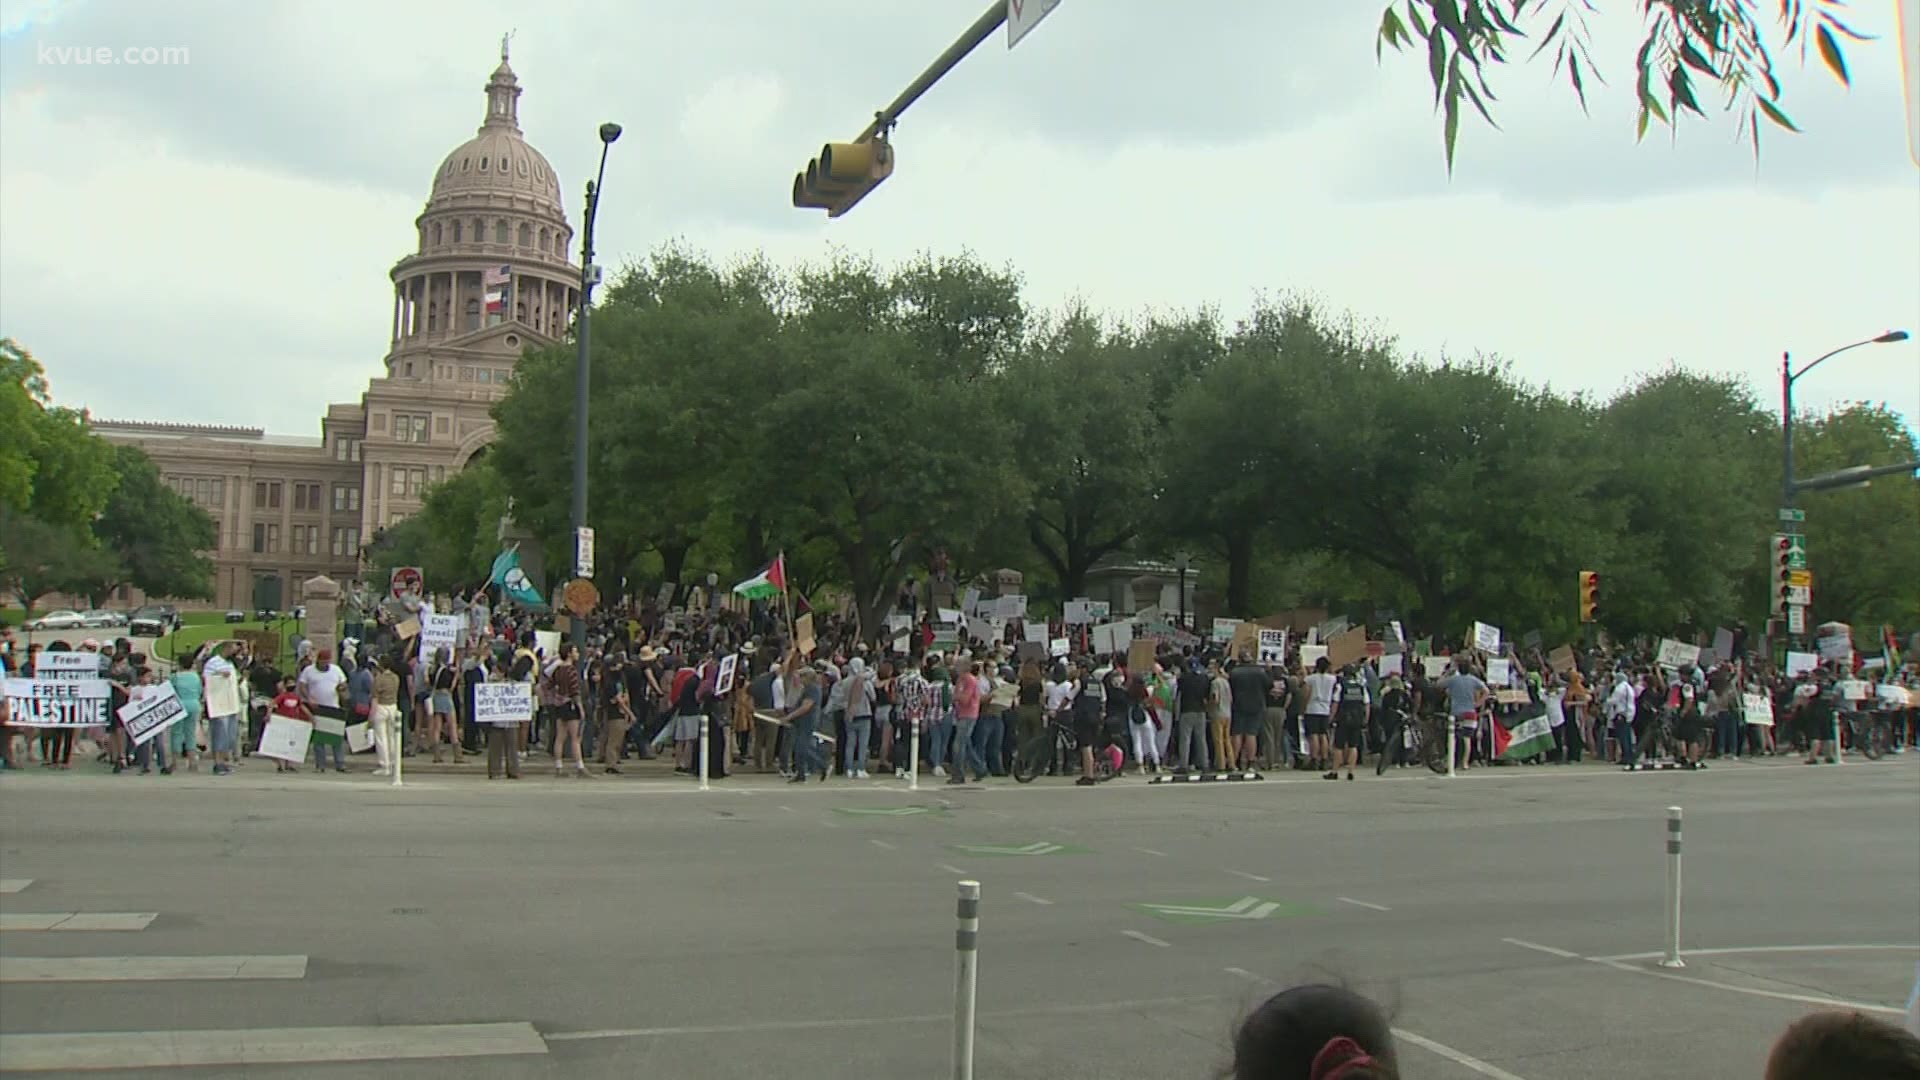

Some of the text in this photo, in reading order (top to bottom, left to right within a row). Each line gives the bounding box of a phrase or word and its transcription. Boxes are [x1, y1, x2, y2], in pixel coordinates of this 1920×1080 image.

[53, 655, 81, 664] Free
[32, 685, 80, 697] FREE
[8, 697, 108, 723] PALESTINE
